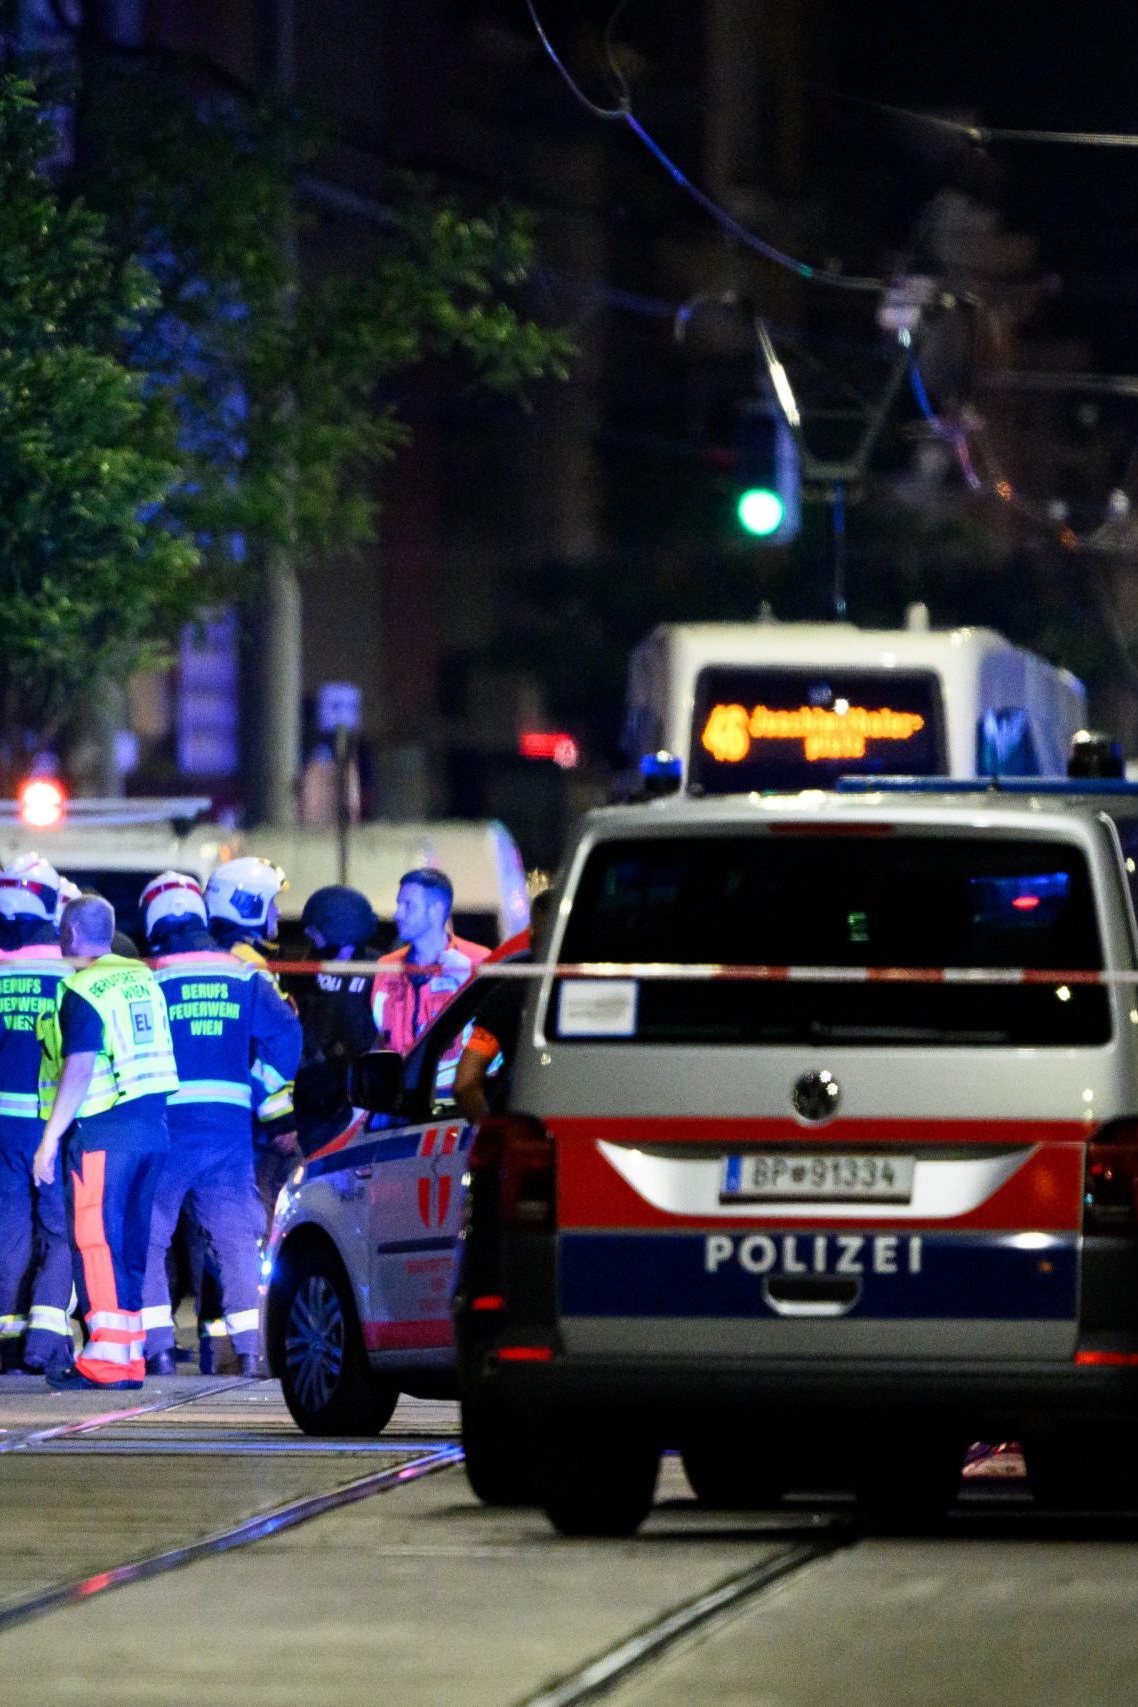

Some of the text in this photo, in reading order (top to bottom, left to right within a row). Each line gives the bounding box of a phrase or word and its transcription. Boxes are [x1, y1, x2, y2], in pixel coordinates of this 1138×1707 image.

[181, 983, 229, 1000] BERUFS
[169, 1001, 240, 1021] FEUERWEHR
[134, 1013, 152, 1032] EL
[190, 1019, 223, 1036] WIEN
[704, 1234, 922, 1274] POLIZEI
